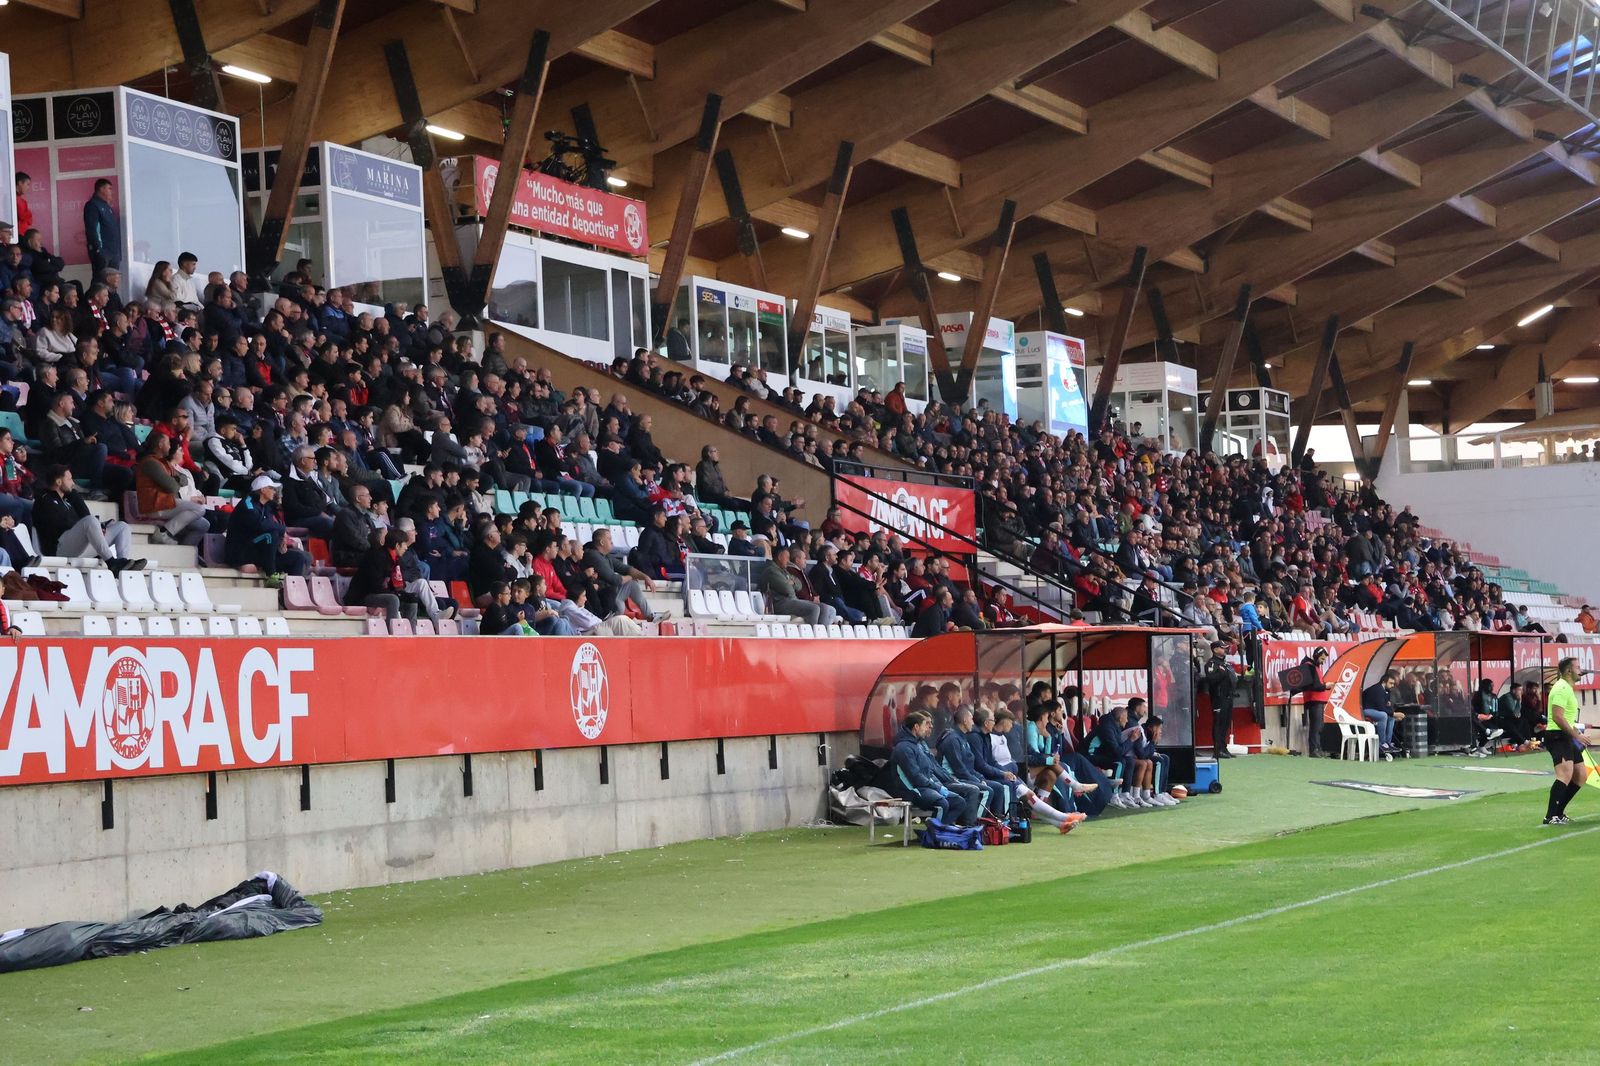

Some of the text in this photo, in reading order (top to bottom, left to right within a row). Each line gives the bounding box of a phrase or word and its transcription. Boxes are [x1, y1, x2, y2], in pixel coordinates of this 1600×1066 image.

[76, 120, 94, 128] TES
[366, 167, 409, 191] MARINA
[512, 201, 529, 218] una
[531, 206, 569, 227] entidad
[566, 192, 585, 212] más
[587, 201, 603, 217] que
[867, 487, 948, 544] ZAMORA CF
[238, 646, 314, 764] CF
